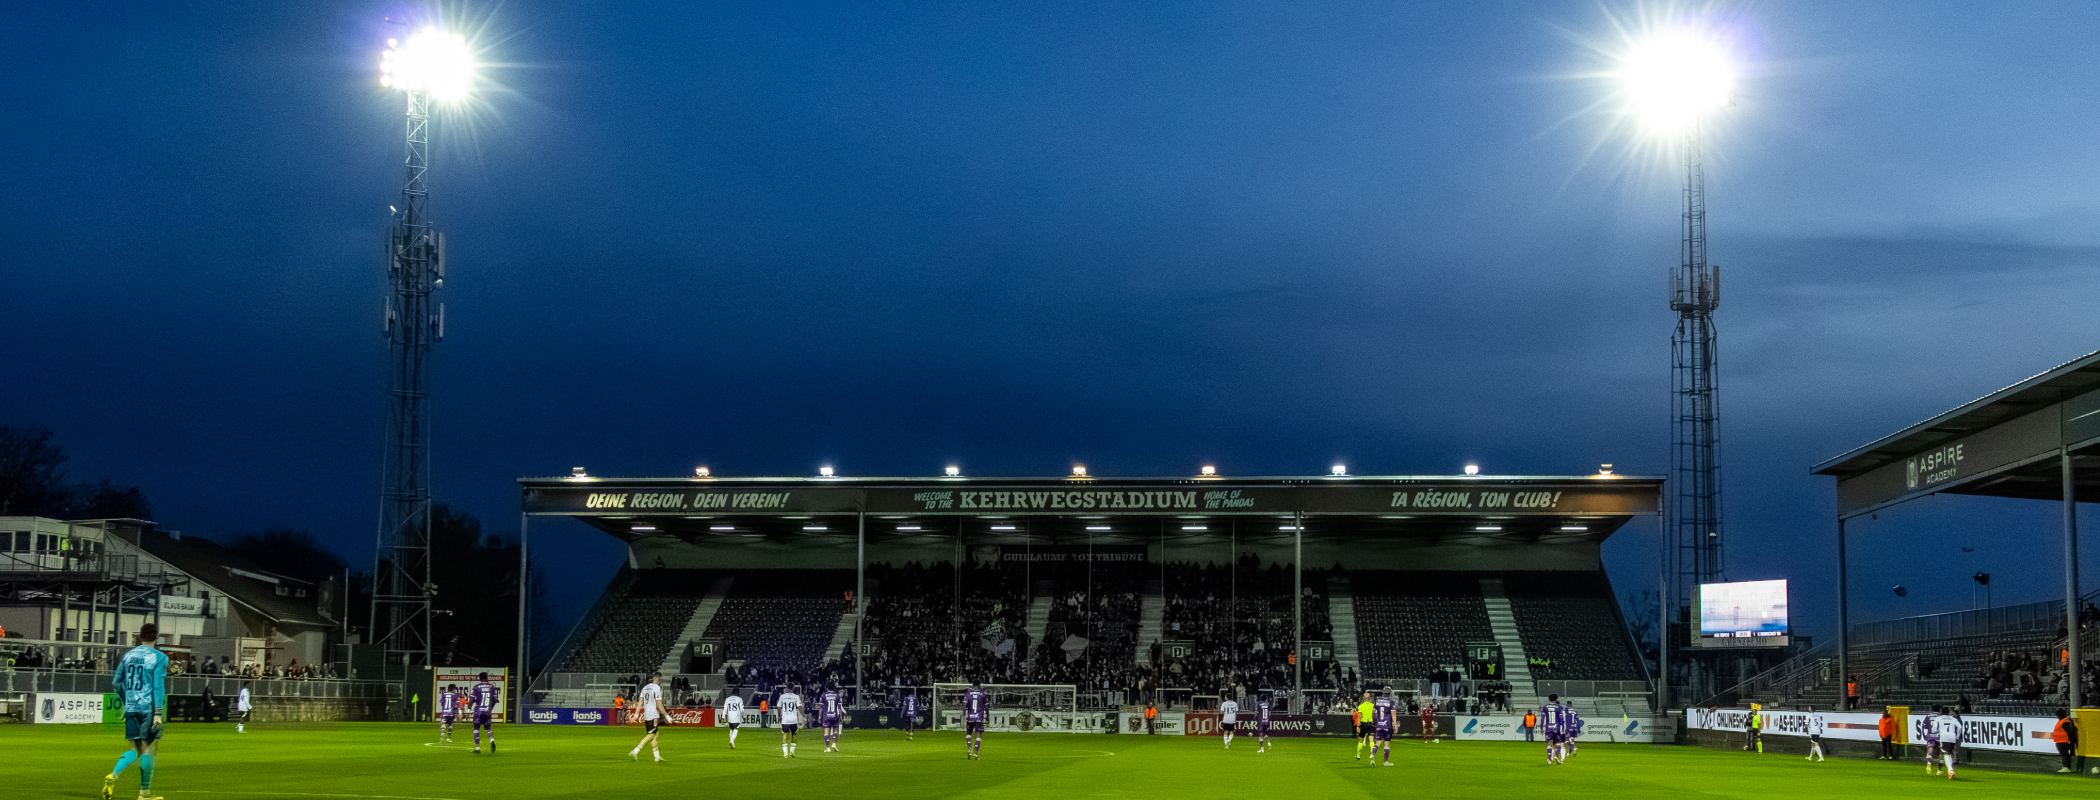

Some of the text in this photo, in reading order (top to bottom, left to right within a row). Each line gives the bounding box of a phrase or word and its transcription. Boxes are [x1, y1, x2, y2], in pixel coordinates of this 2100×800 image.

[1920, 444, 1964, 473] ASPIRE
[1926, 467, 1957, 483] ACADEMY
[914, 491, 953, 501] WELCOME
[960, 491, 1197, 508] KEHRWEGSTADIUM
[1204, 490, 1242, 500] HOME OF
[1391, 488, 1562, 509] TA RÉGION, TON CLUB!
[586, 492, 790, 509] DEINE REGION, DEIN VEREIN!
[925, 500, 953, 509] TO THE
[1205, 498, 1254, 509] THE PANDAS
[1003, 553, 1068, 561] GUILLAUME
[1095, 552, 1144, 561] TRIBÜNE
[703, 645, 712, 654] A
[1480, 649, 1488, 658] F
[127, 664, 143, 691] 33
[645, 692, 650, 704] 9
[59, 699, 103, 710] ASPIRE
[727, 703, 738, 711] 18
[783, 702, 795, 712] 19
[529, 711, 558, 720] liantis
[573, 711, 602, 720] liantis
[742, 715, 782, 724] SEBATIA
[1717, 712, 1747, 729] ONLINESHO
[1269, 721, 1311, 730] IRWAYS
[1944, 722, 1951, 732] 7
